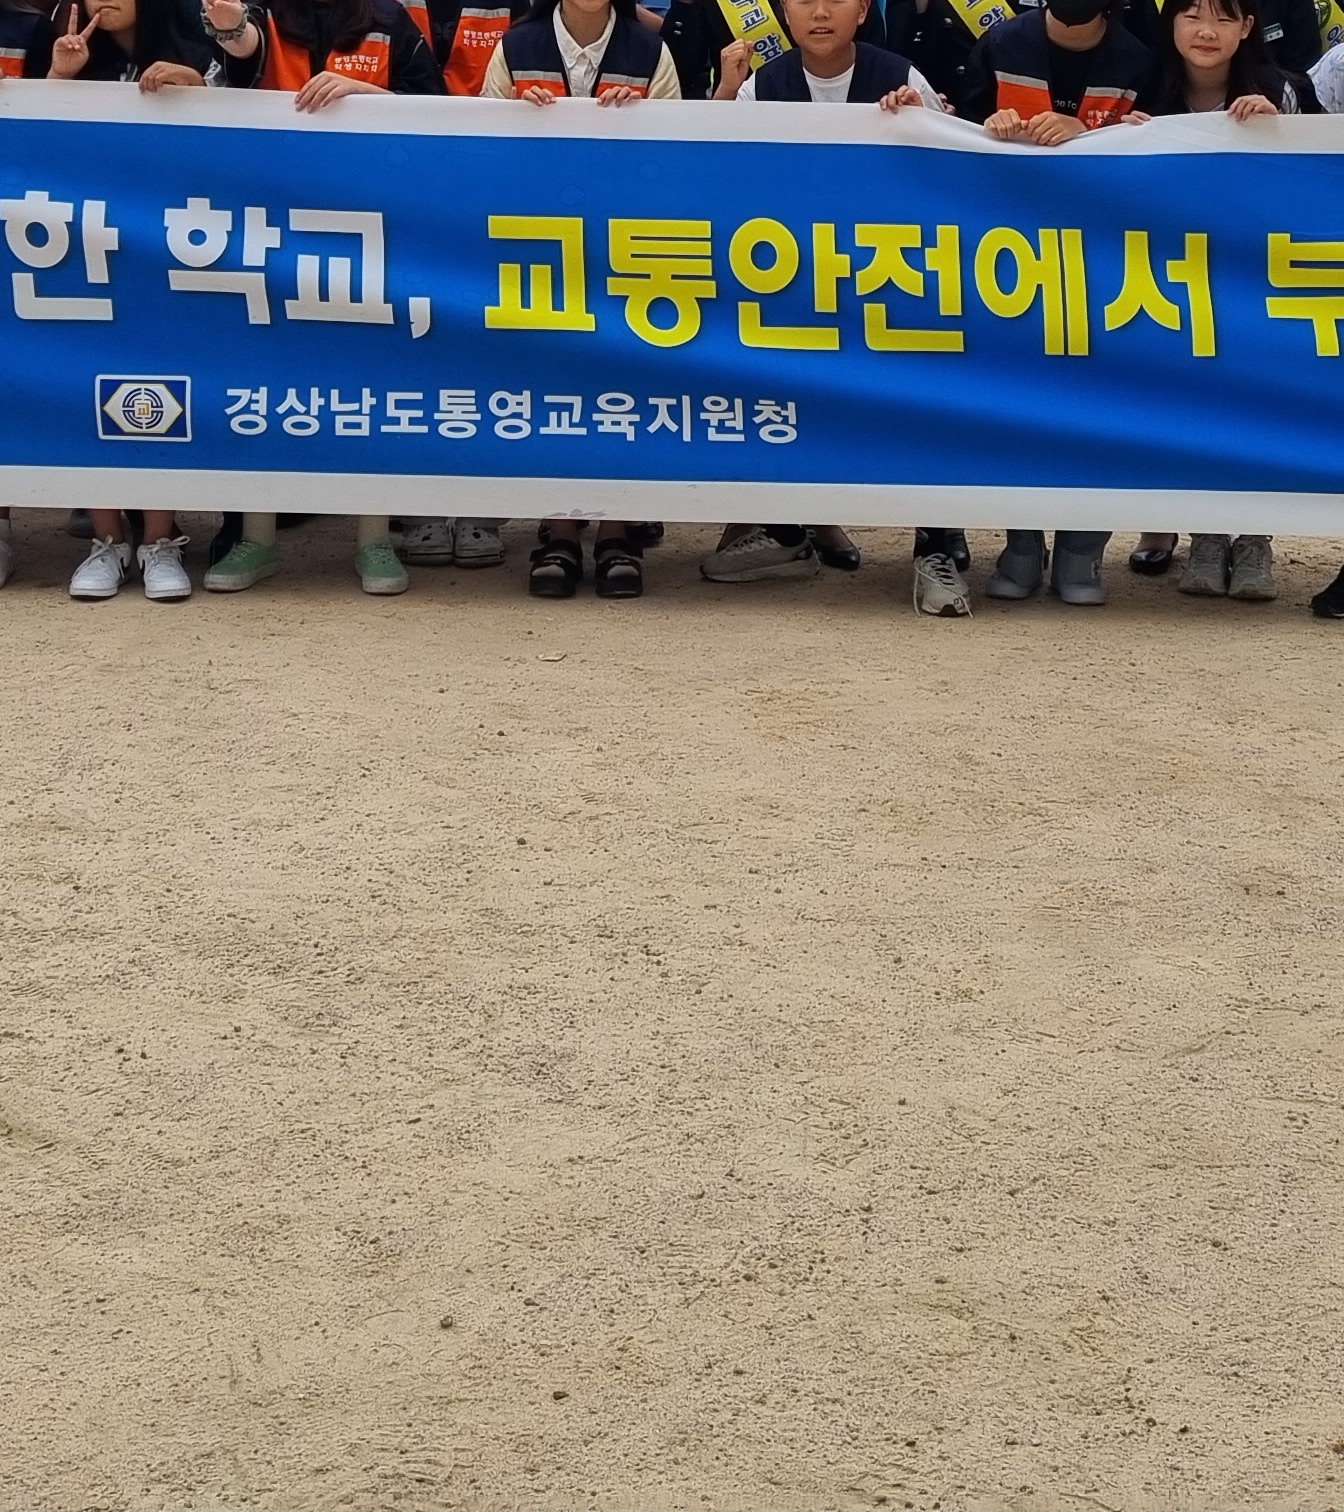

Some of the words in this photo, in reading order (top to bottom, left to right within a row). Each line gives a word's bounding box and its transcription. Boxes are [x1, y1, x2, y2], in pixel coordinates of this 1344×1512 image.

[163, 197, 431, 339] 학교,
[485, 215, 1216, 357] 교통안전에서
[224, 385, 799, 445] 경상남도통영교육지원청
